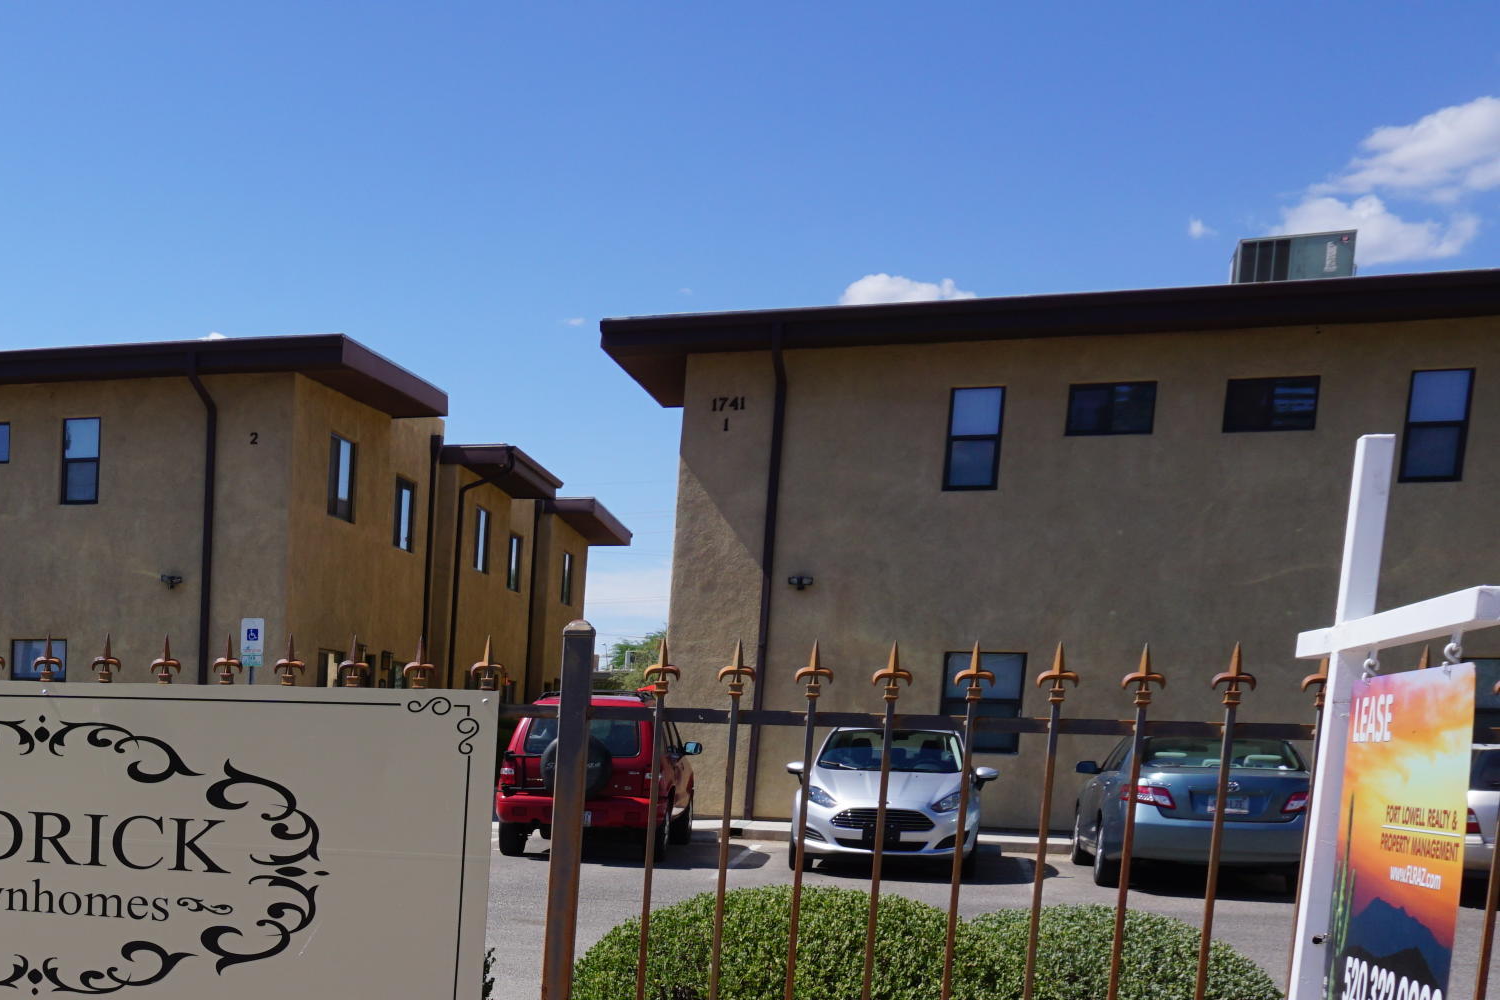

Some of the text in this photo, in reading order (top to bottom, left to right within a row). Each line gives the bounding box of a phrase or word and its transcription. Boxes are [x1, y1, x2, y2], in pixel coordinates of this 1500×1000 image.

[711, 396, 746, 412] 1741
[723, 418, 729, 432] 1
[250, 432, 258, 445] 2
[1352, 694, 1393, 743] LEASE
[1386, 804, 1458, 831] FORT LOWELL REALTY &
[1380, 832, 1460, 862] PROPERTY MANAGEMENT
